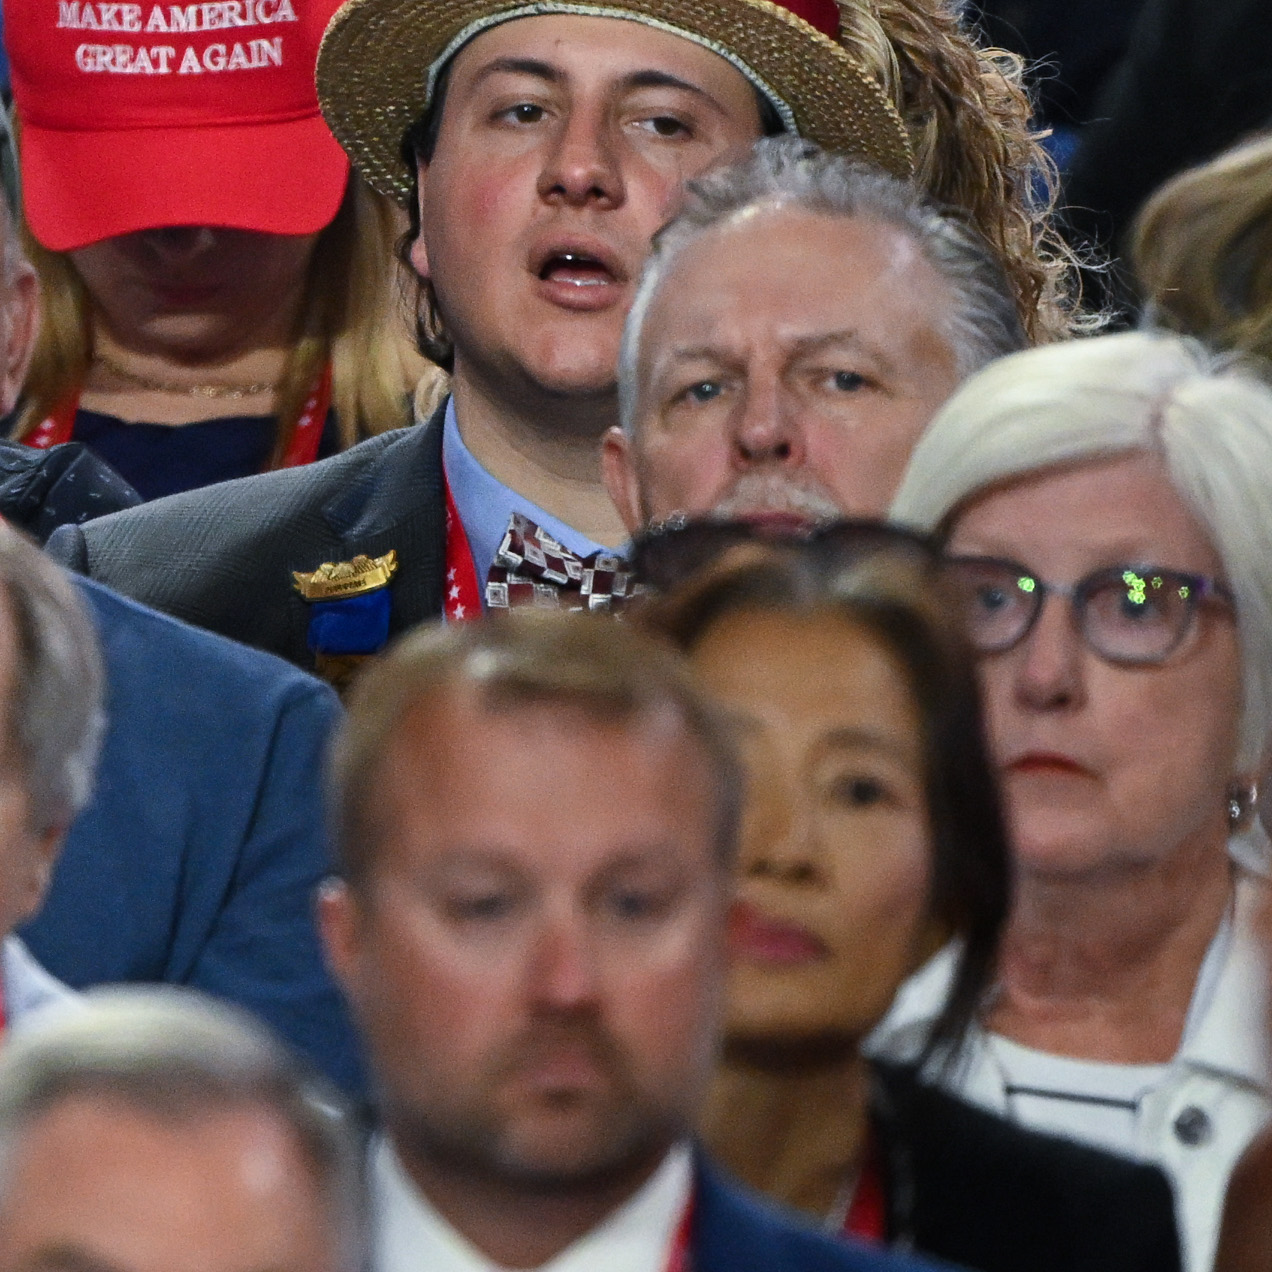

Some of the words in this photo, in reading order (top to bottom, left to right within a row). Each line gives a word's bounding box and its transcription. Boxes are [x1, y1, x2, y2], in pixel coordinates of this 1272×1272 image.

[56, 0, 143, 33] MAKE
[75, 42, 176, 75] GREAT
[177, 36, 283, 75] AGAIN
